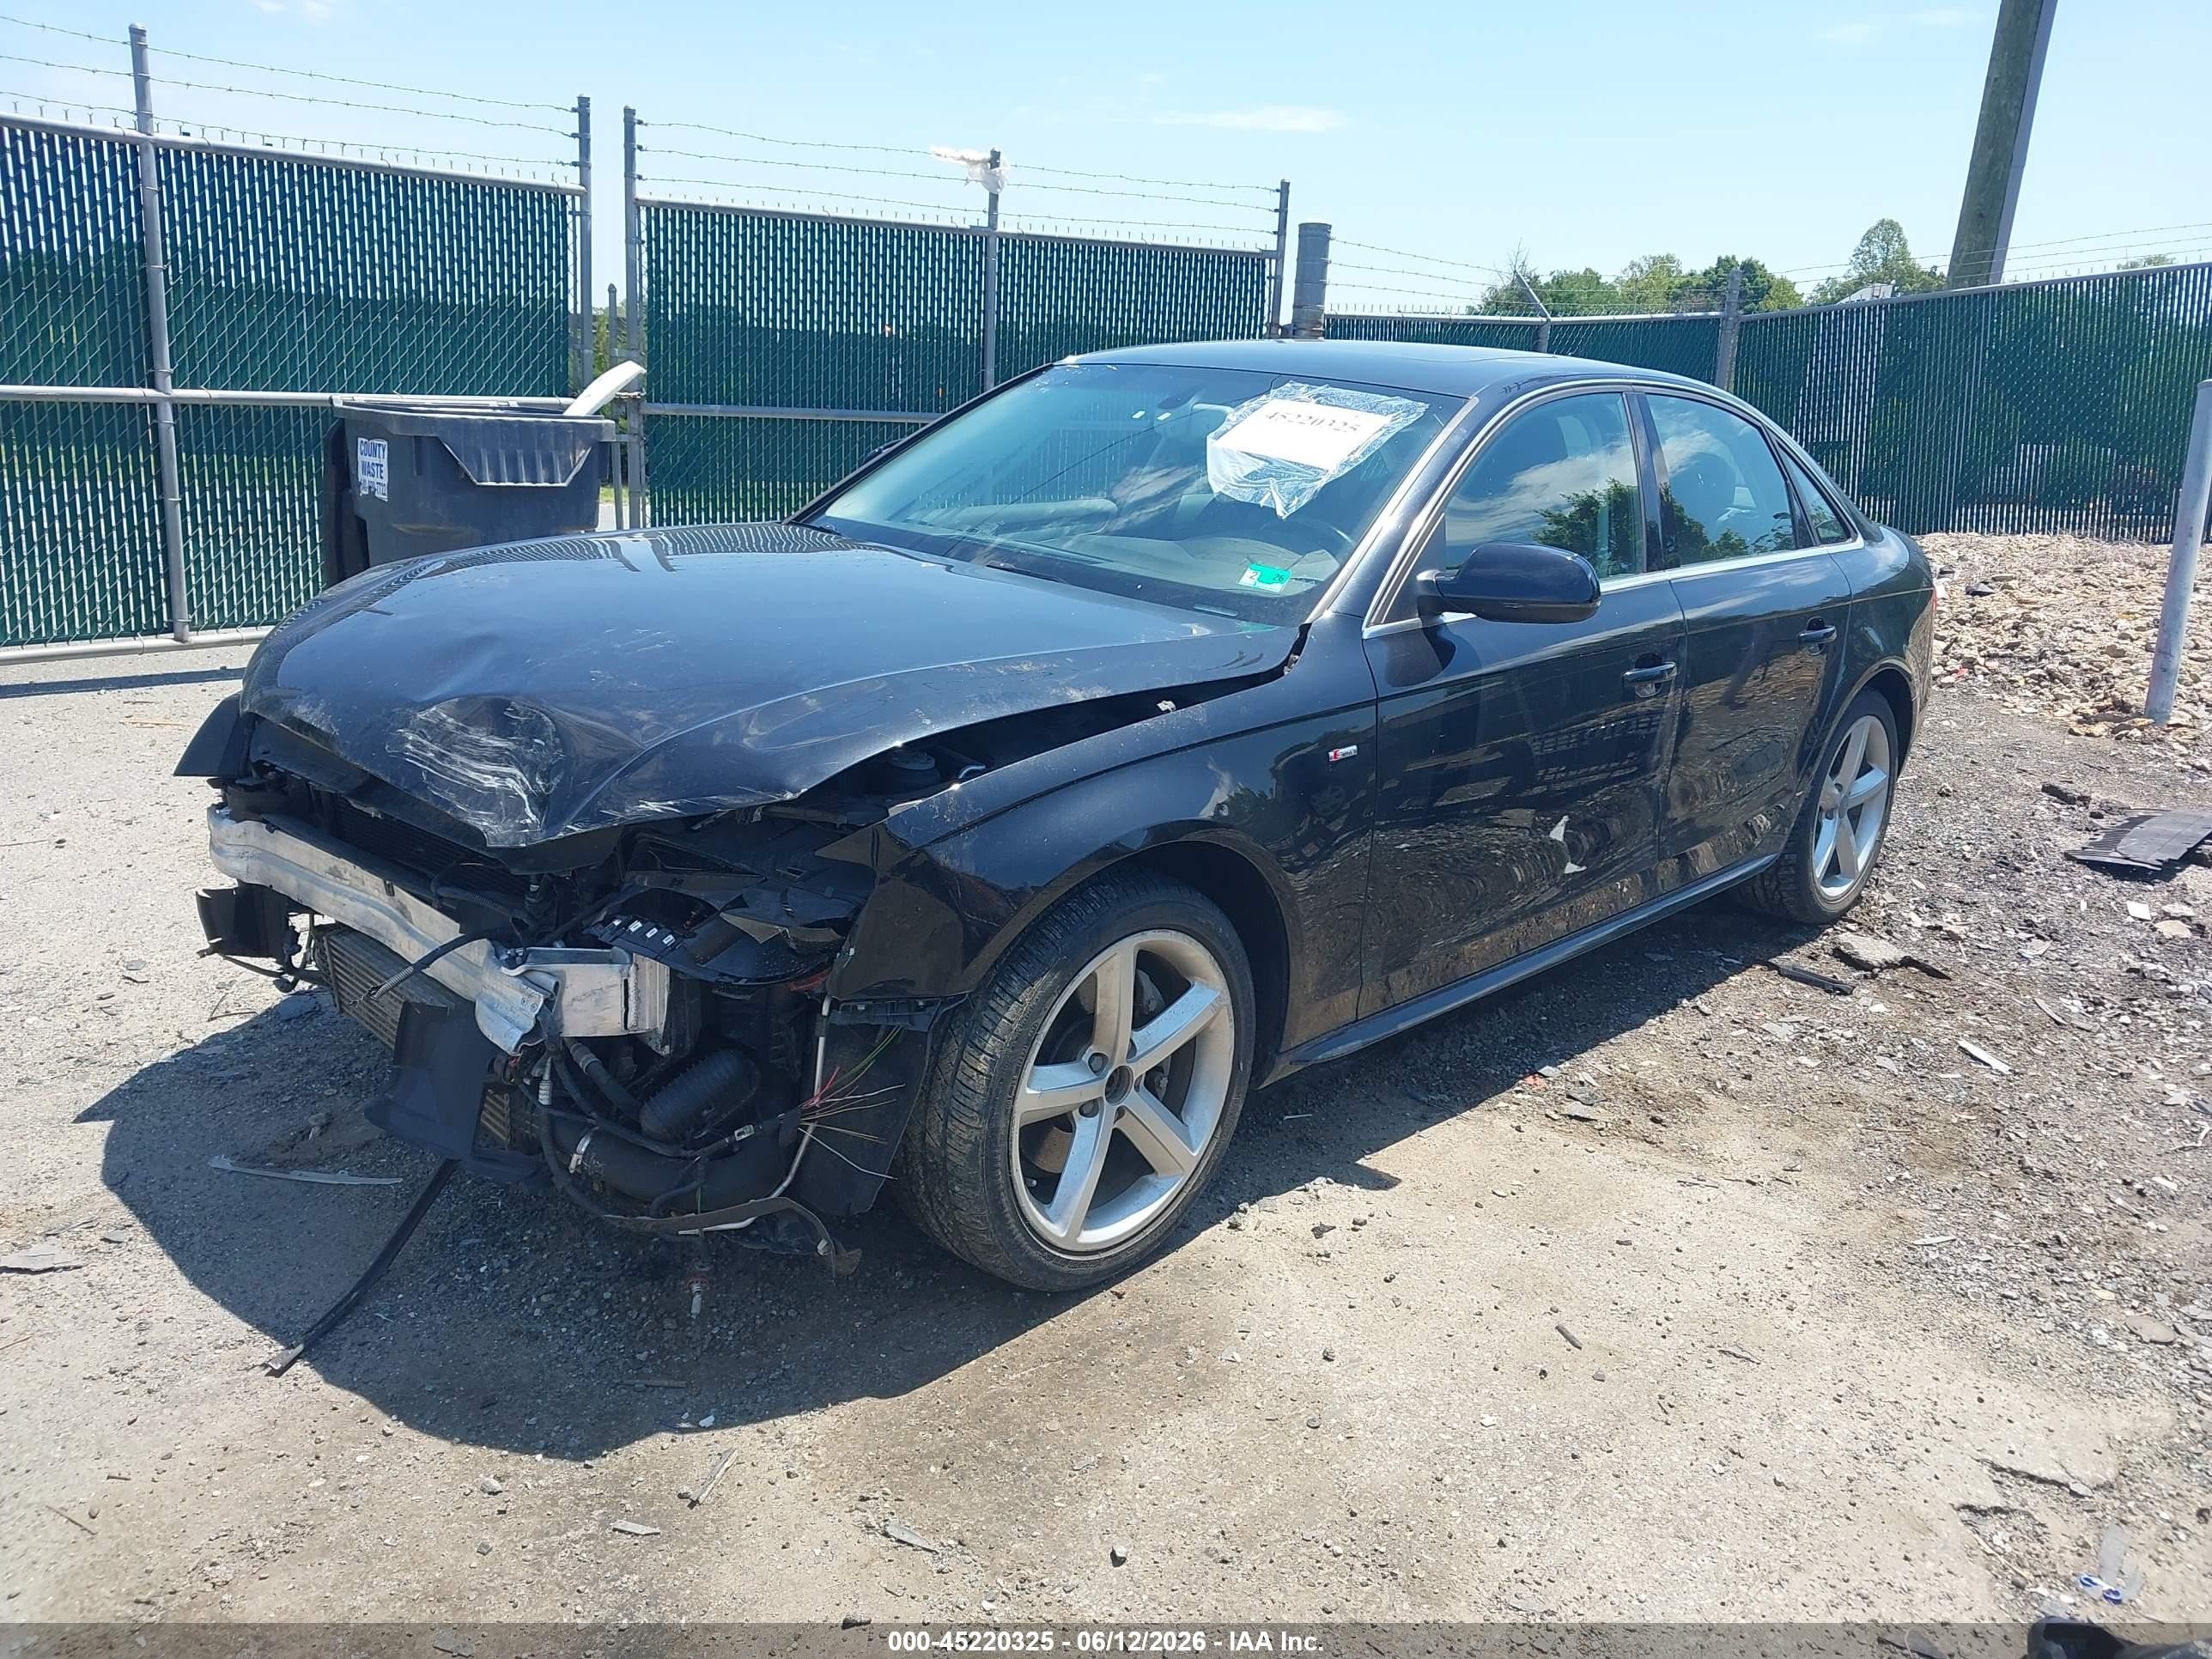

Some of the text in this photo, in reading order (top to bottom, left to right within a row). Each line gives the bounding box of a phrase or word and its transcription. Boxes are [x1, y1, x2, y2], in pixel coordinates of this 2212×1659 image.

[360, 440, 386, 459] COUNTY
[361, 460, 384, 479] WASTE
[1272, 573, 1285, 582] 26
